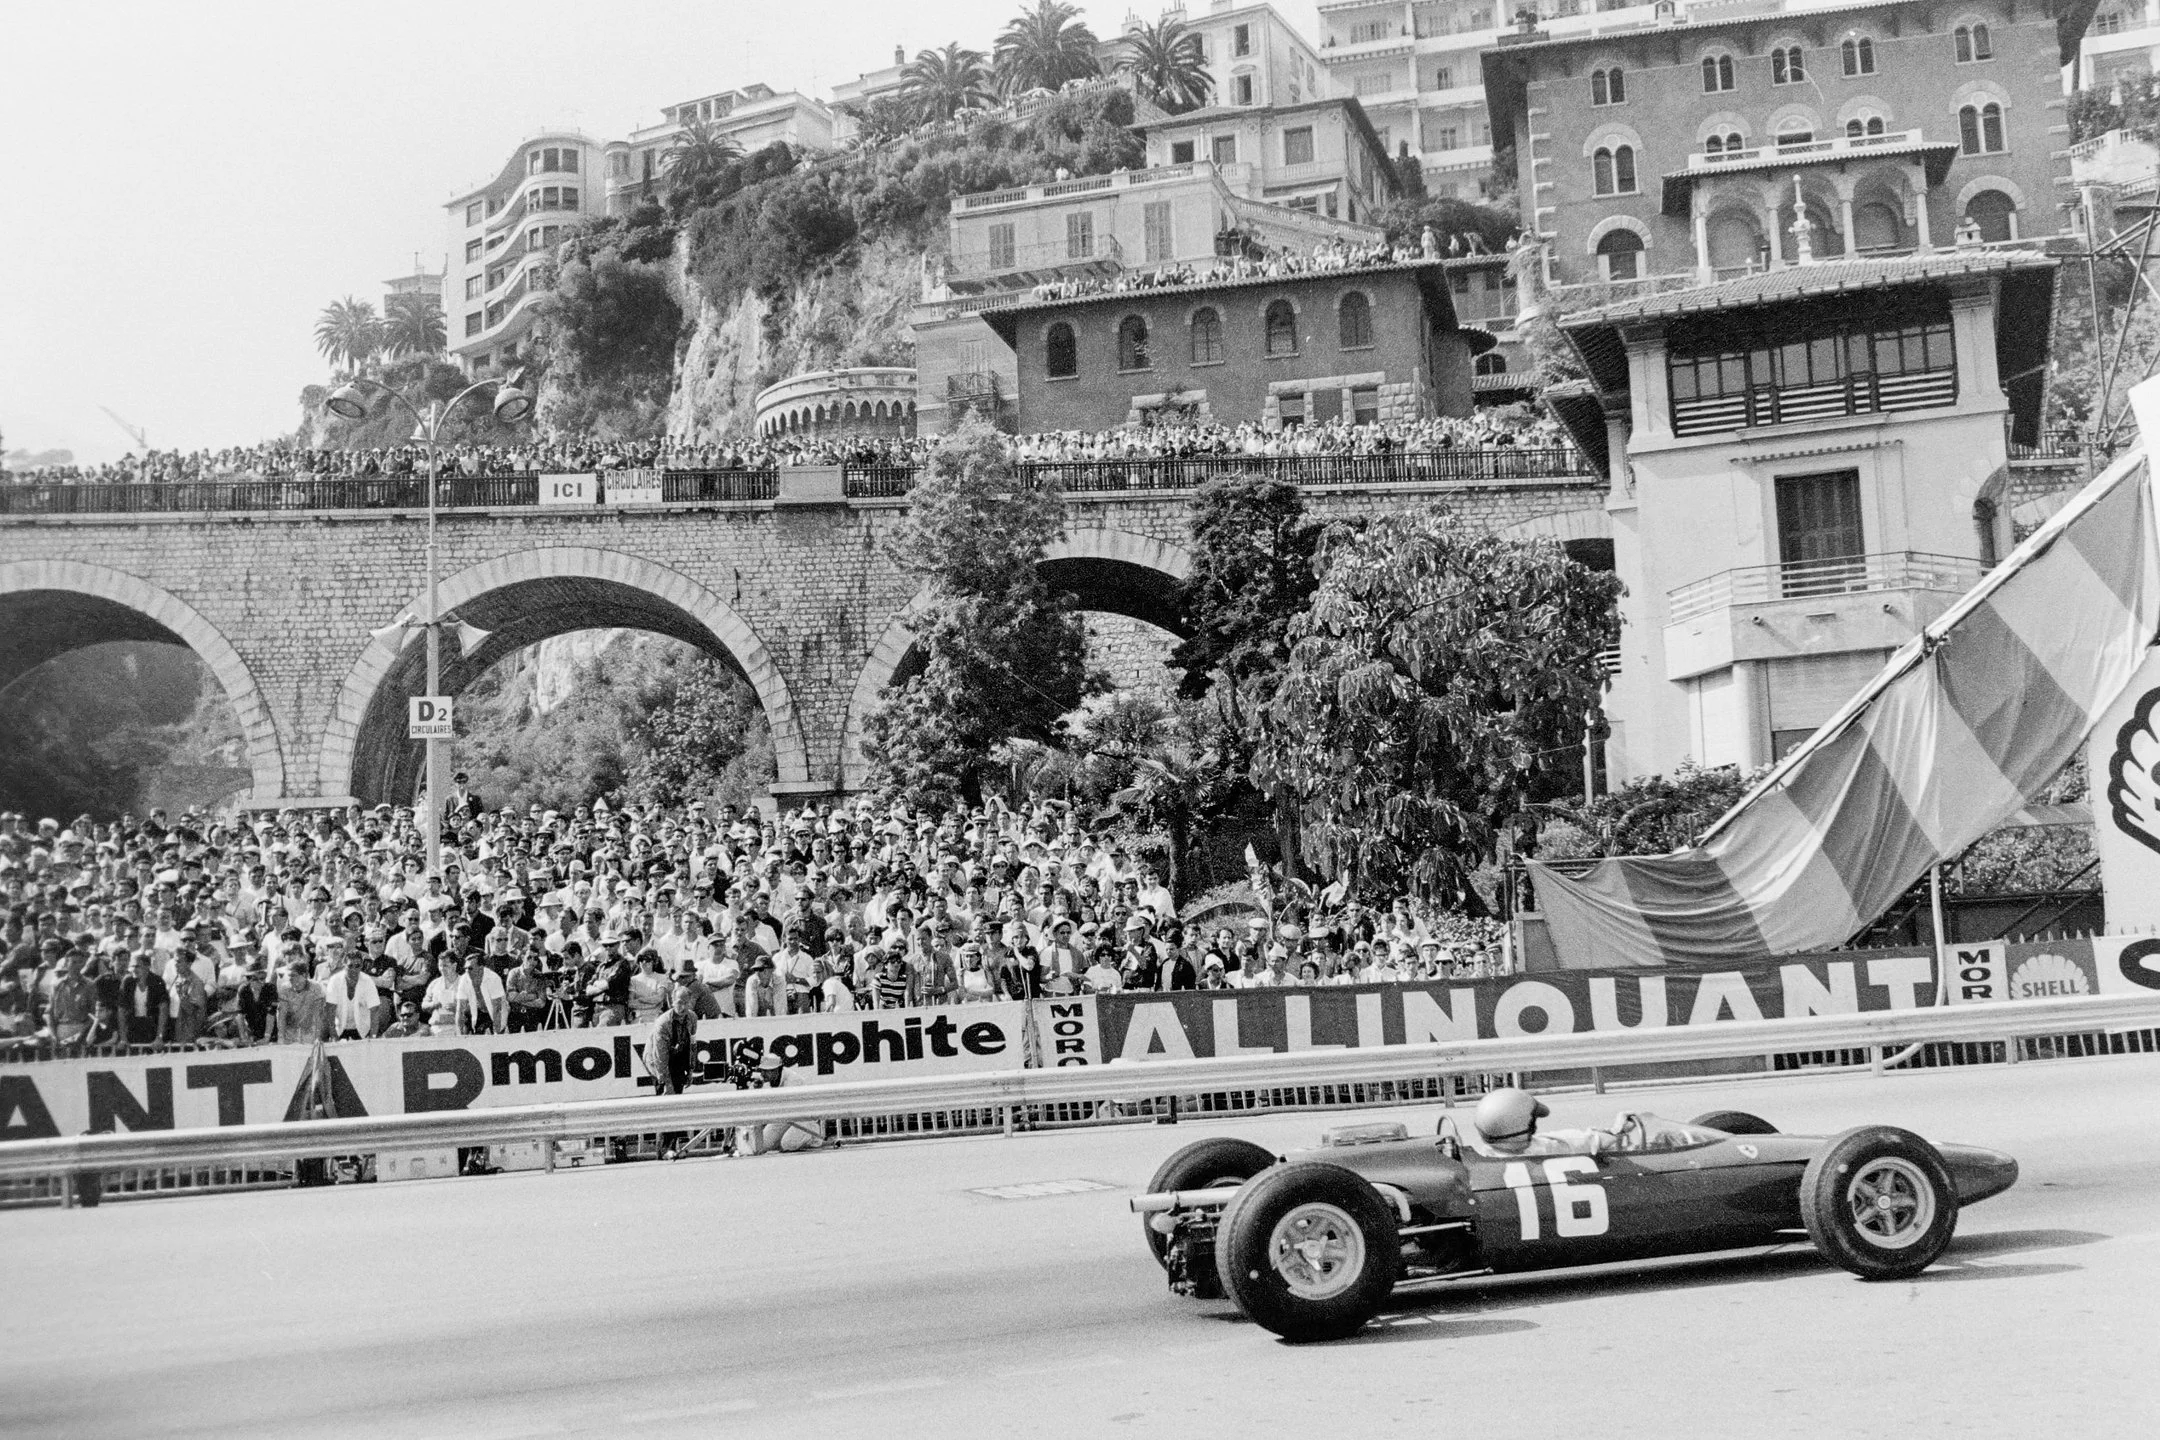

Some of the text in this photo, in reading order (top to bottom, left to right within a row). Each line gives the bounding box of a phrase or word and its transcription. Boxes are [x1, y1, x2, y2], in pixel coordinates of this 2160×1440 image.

[607, 471, 661, 490] CIRCULAIRES
[554, 483, 582, 497] ICI
[412, 725, 451, 734] CIRCULAIRES
[1957, 949, 1993, 1003] MOR
[2022, 979, 2079, 997] SHELL
[1503, 1156, 1609, 1240] 16
